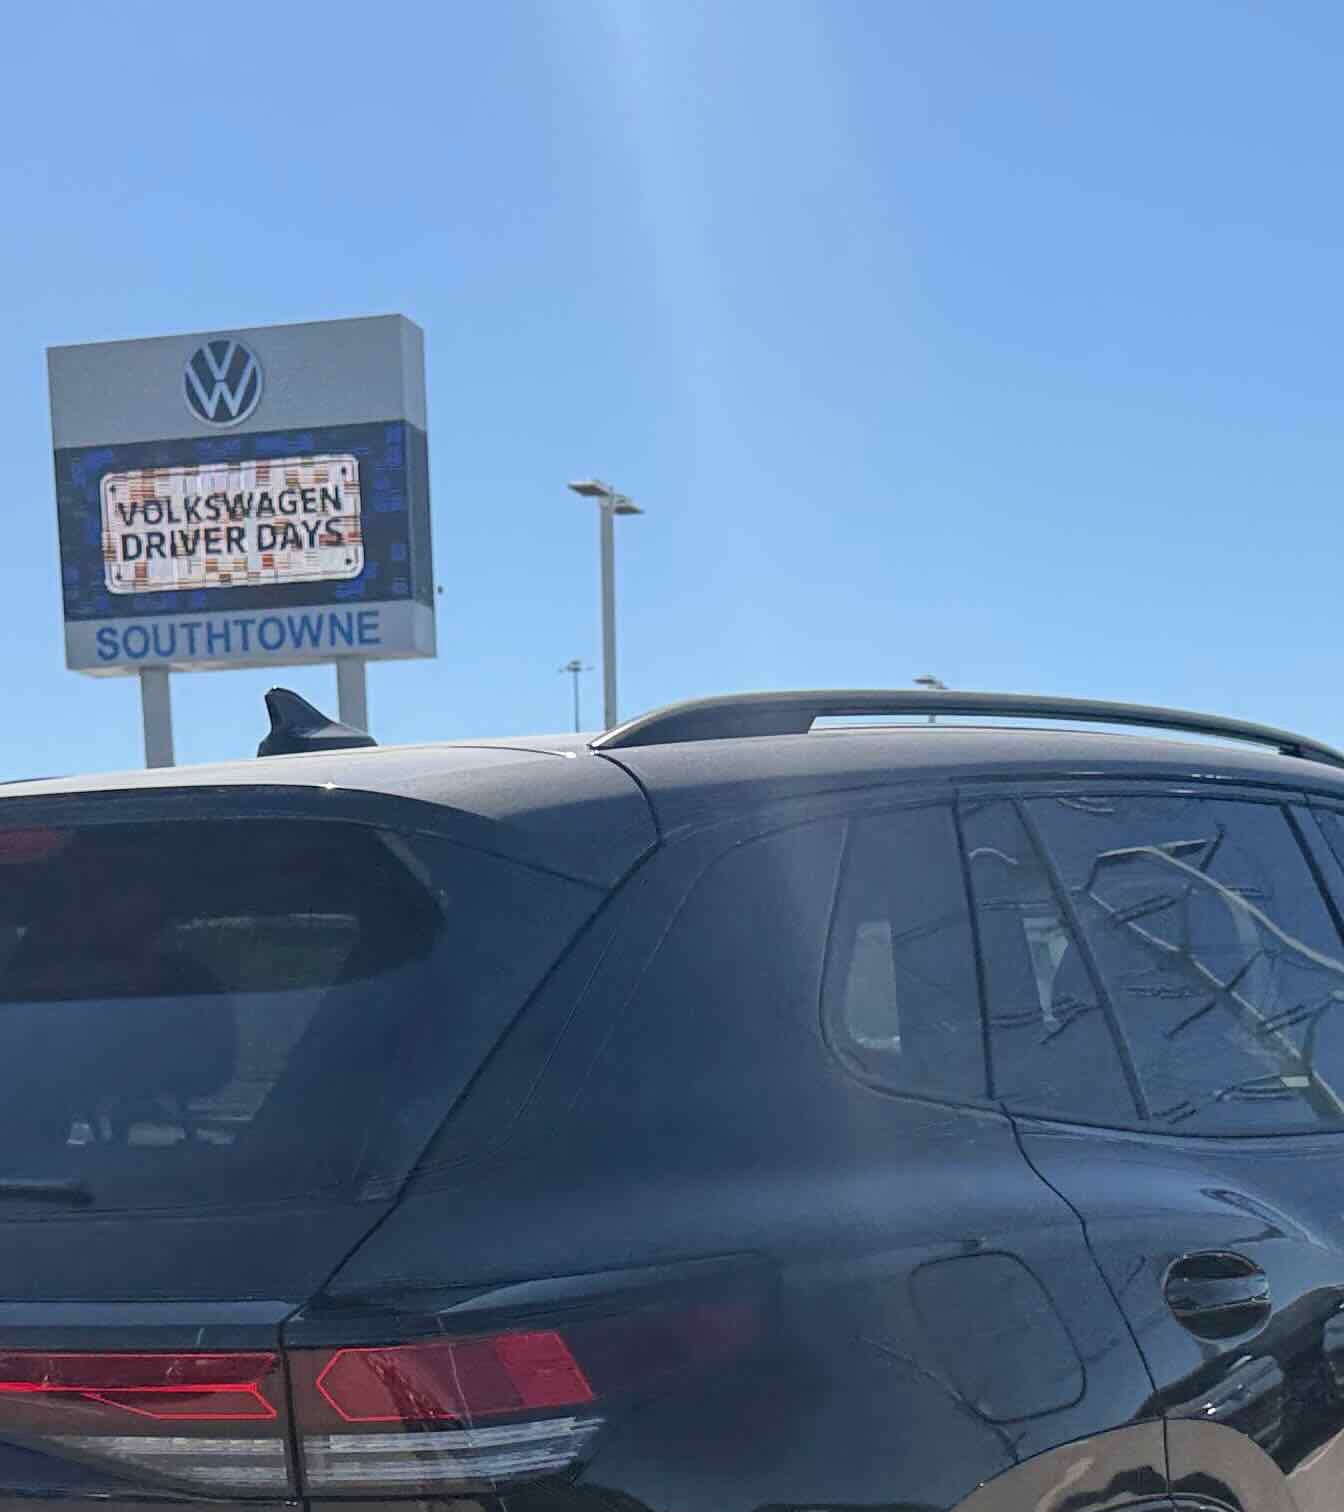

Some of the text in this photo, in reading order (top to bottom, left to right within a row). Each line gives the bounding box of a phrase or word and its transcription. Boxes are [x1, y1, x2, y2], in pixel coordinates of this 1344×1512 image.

[185, 340, 261, 424] VW
[117, 486, 343, 527] VOLKSWAGEN
[121, 516, 344, 562] DRIVER DAYS
[95, 610, 382, 661] SOUTHTOWNE
